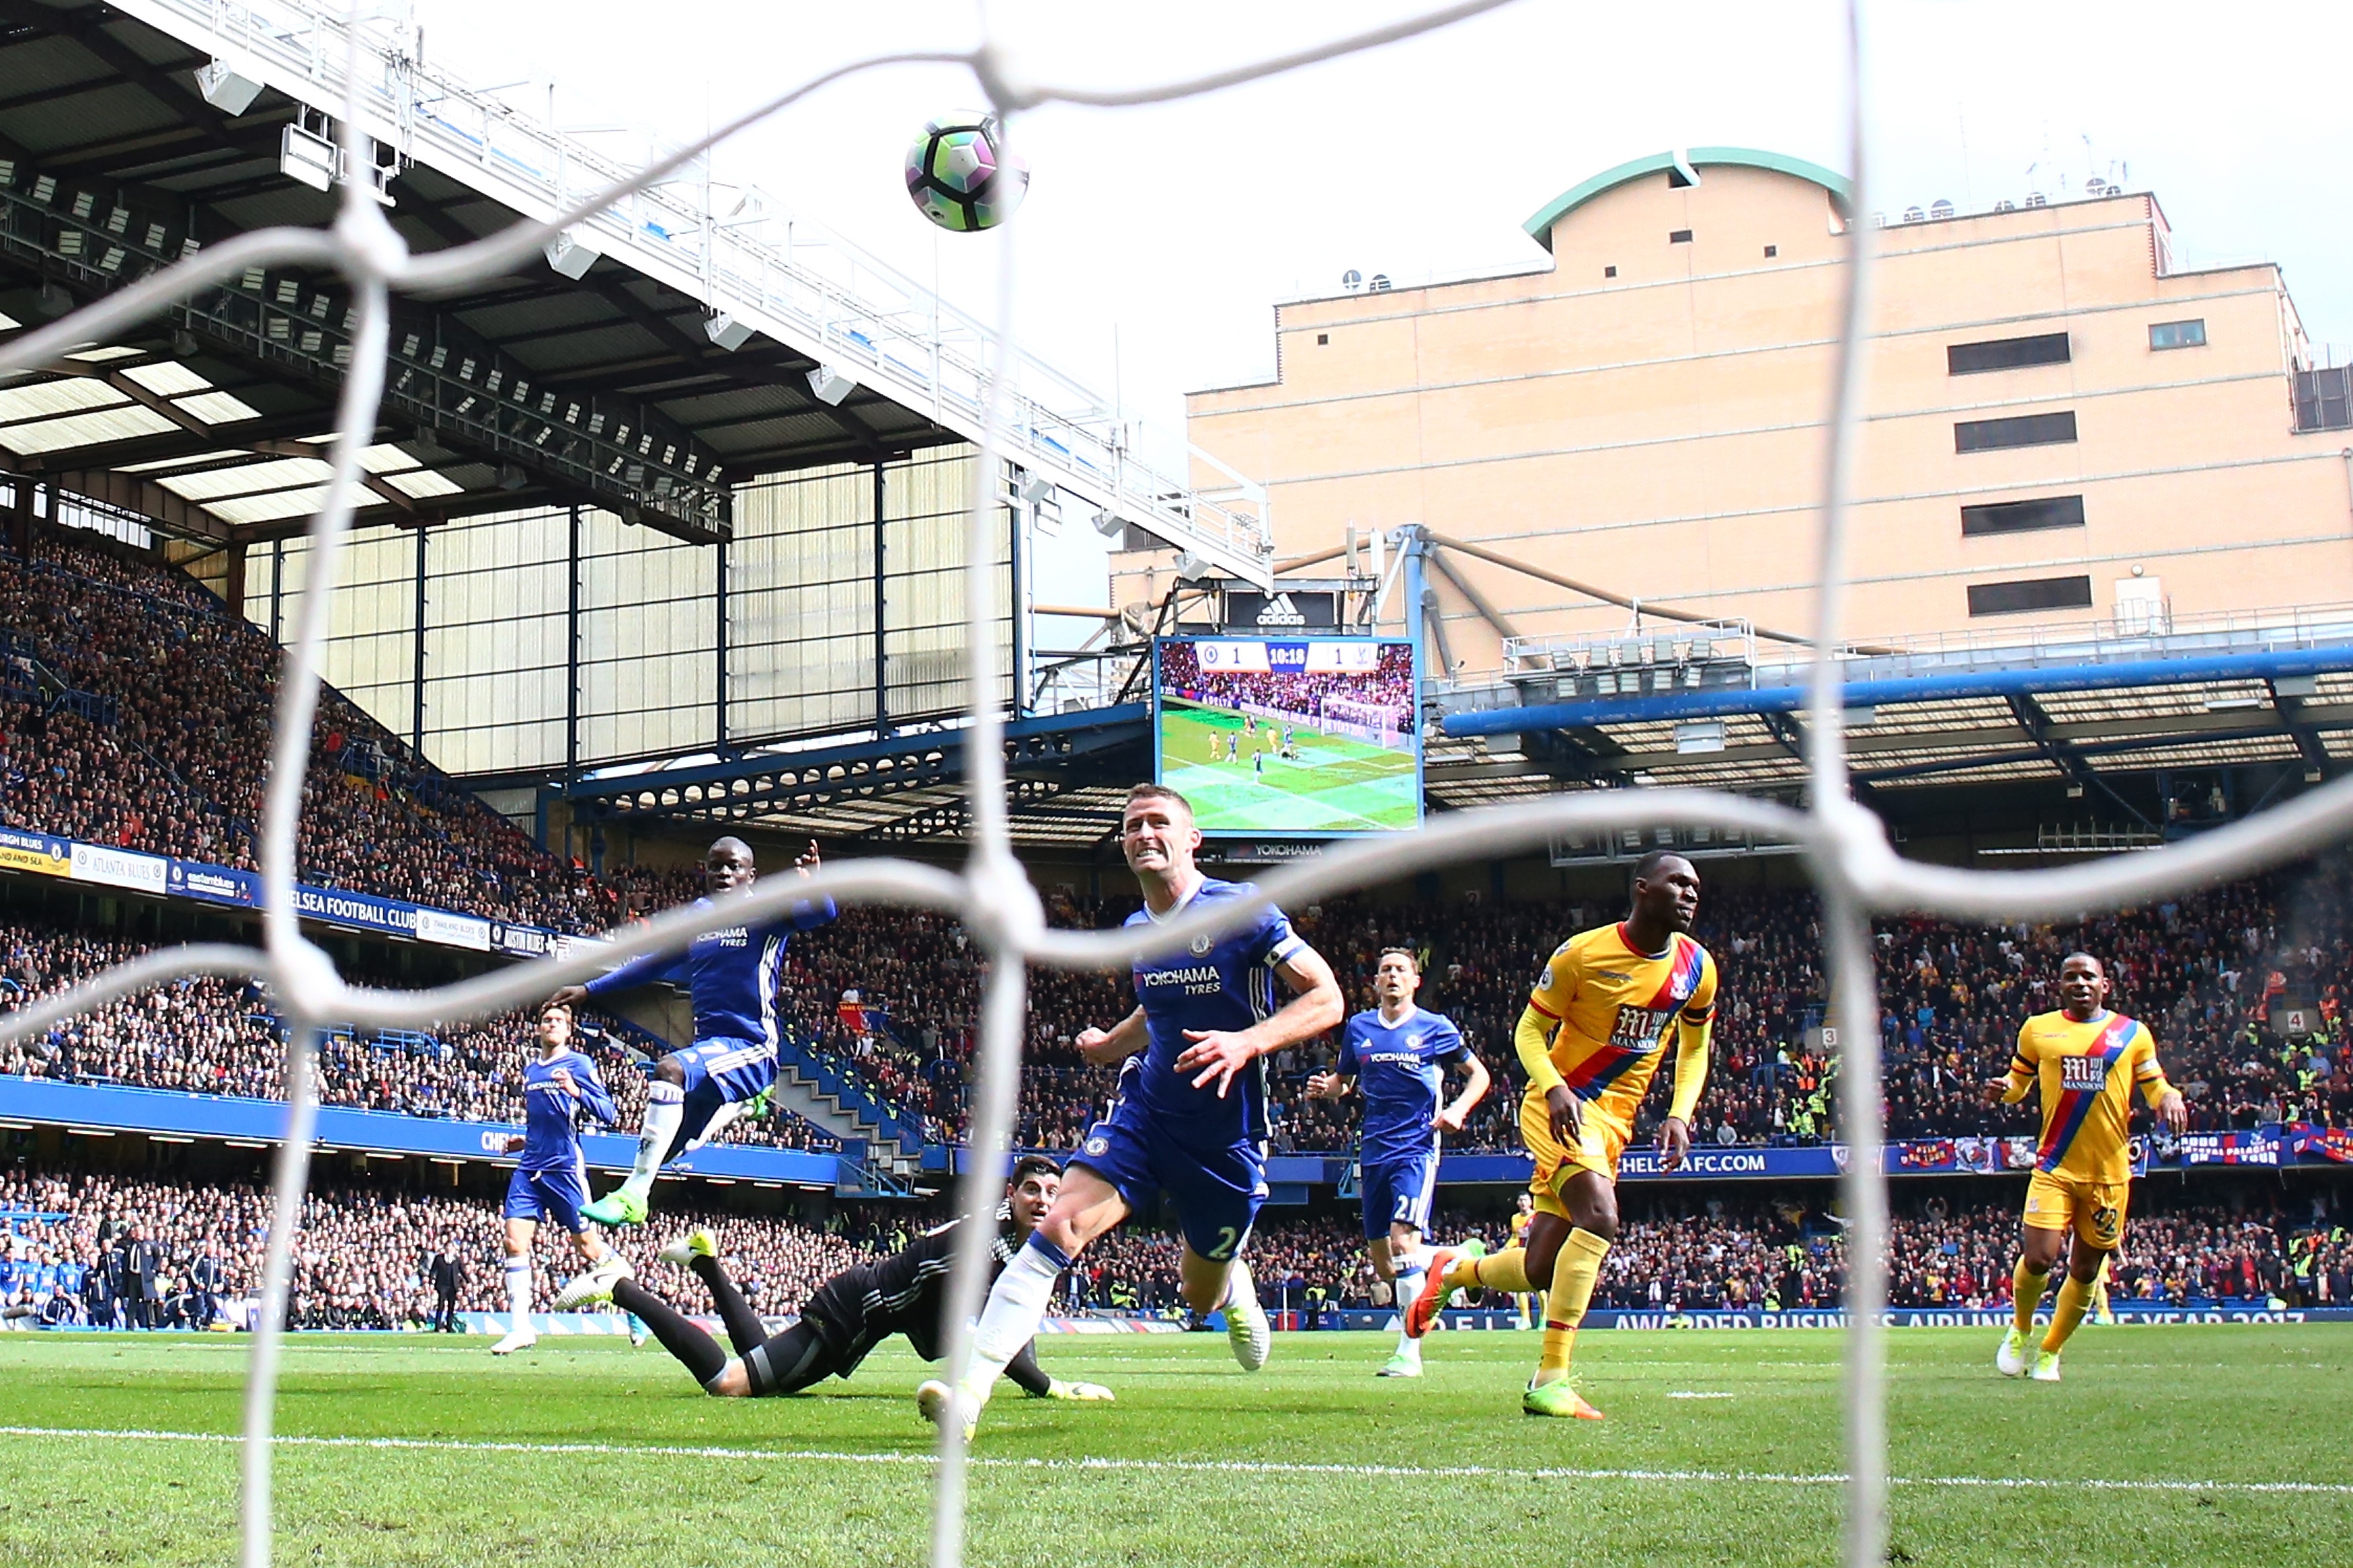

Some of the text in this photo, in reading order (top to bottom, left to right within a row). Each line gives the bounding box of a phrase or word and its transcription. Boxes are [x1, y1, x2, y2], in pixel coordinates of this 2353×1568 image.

[1256, 613, 1306, 626] adidas
[1233, 647, 1343, 665] 1 10:18 1
[1256, 845, 1322, 856] YOKOHAMA
[93, 857, 150, 880] ATLANTA BLUES
[326, 897, 386, 924] FOOTBALL
[387, 909, 417, 930] CLUB
[719, 938, 748, 947] TYRES
[1142, 965, 1220, 987] YOKOHAMA
[1185, 982, 1221, 995] TYRES
[2290, 1013, 2301, 1026] 4
[1825, 1030, 1835, 1043] 3
[1369, 1053, 1421, 1064] YOKOHAMA
[2063, 1080, 2104, 1090] MANSION
[2226, 1145, 2265, 1155] PALACE
[1394, 1194, 1419, 1221] 21
[1207, 1226, 1236, 1259] 2
